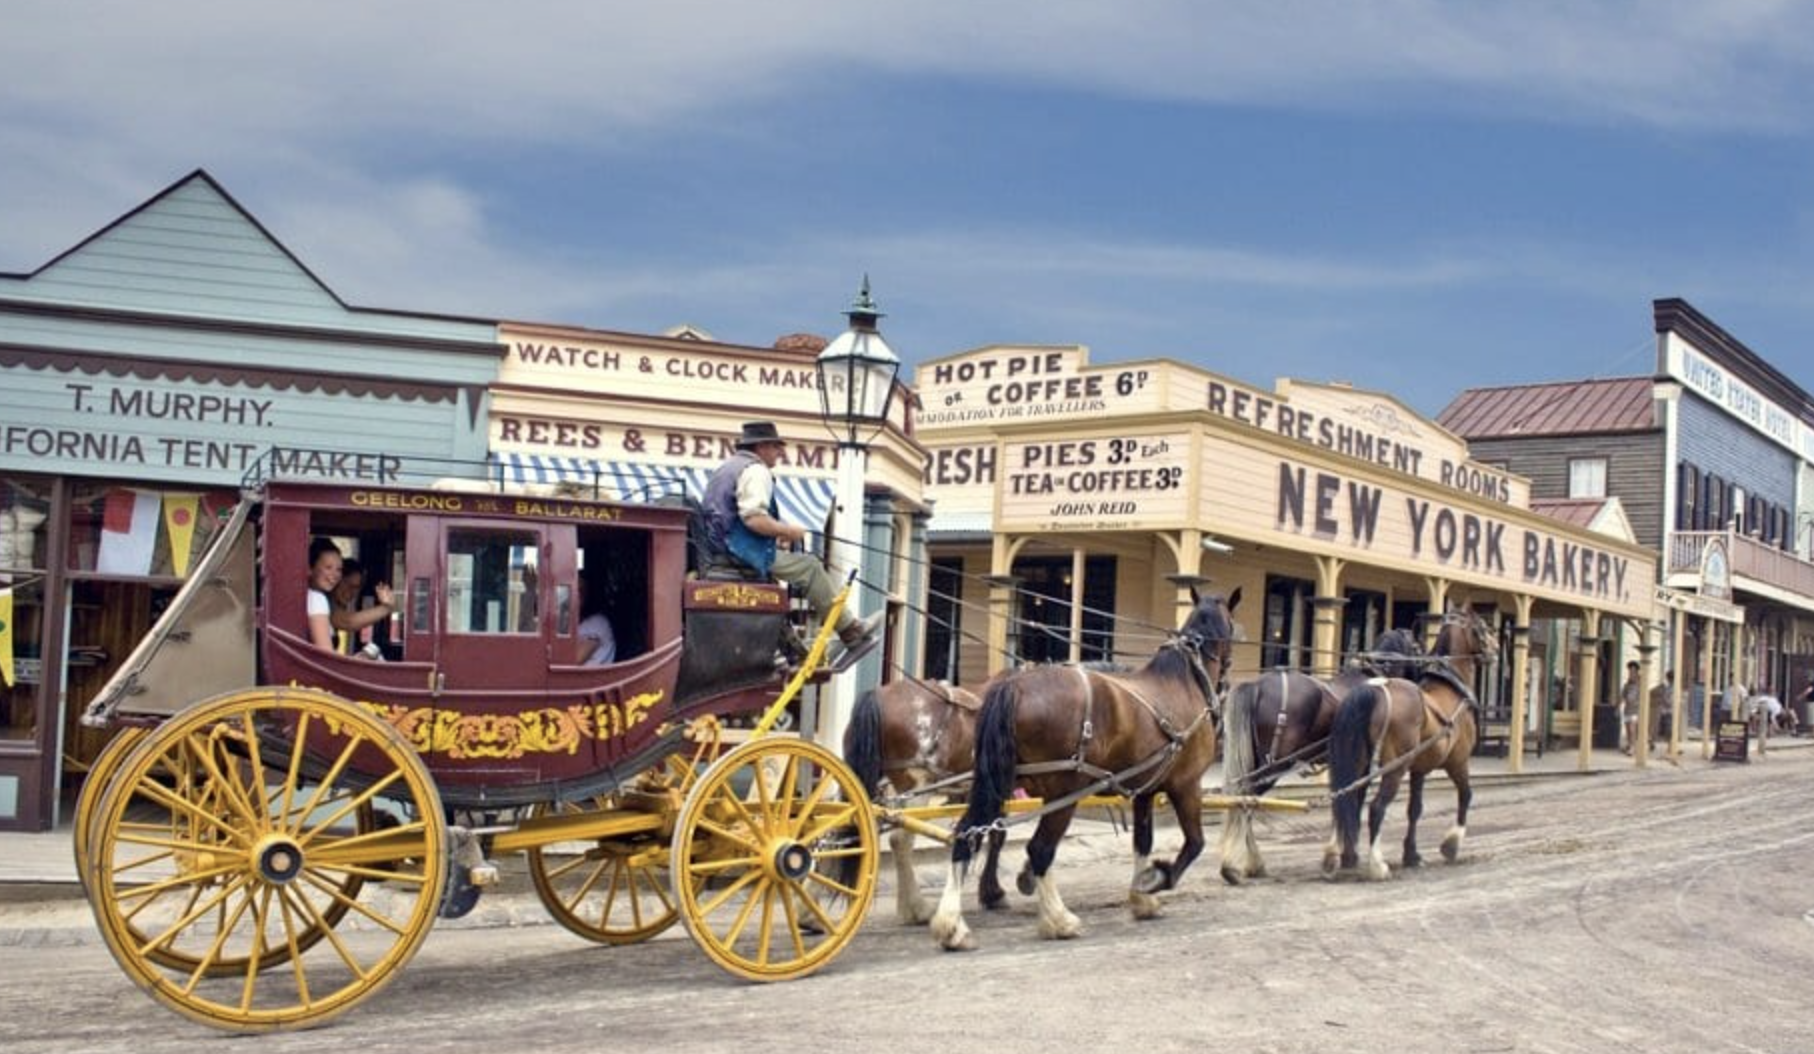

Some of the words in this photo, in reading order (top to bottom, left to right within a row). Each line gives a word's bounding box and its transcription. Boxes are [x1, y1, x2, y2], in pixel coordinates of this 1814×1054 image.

[517, 342, 621, 371] WATCH
[638, 356, 653, 374] &
[665, 358, 748, 383] CLOCK
[935, 360, 997, 384] HOT
[1007, 353, 1063, 377] PIE
[66, 384, 93, 413] T.
[110, 387, 273, 427] MURPHY.
[987, 375, 1103, 405] COFFEE
[1028, 400, 1106, 416] TRAVELLERS
[501, 418, 600, 448] REES
[623, 428, 646, 452] &
[1208, 381, 1423, 478] REFRESHMENT
[1440, 459, 1510, 503] ROOMS
[0, 425, 145, 463] FORNIA
[158, 438, 256, 471] TENT
[271, 448, 401, 481] MAKER
[1023, 442, 1096, 468] PIES
[1010, 473, 1053, 495] TEA
[1068, 469, 1152, 493] COFFEE
[351, 491, 463, 511] GEELONG
[515, 501, 624, 521] BALLARAT
[1050, 502, 1095, 517] JOHN
[1099, 501, 1137, 515] REID
[1277, 461, 1381, 545] NEW
[1406, 496, 1504, 577] YORK
[1523, 531, 1630, 603] BAKERY.
